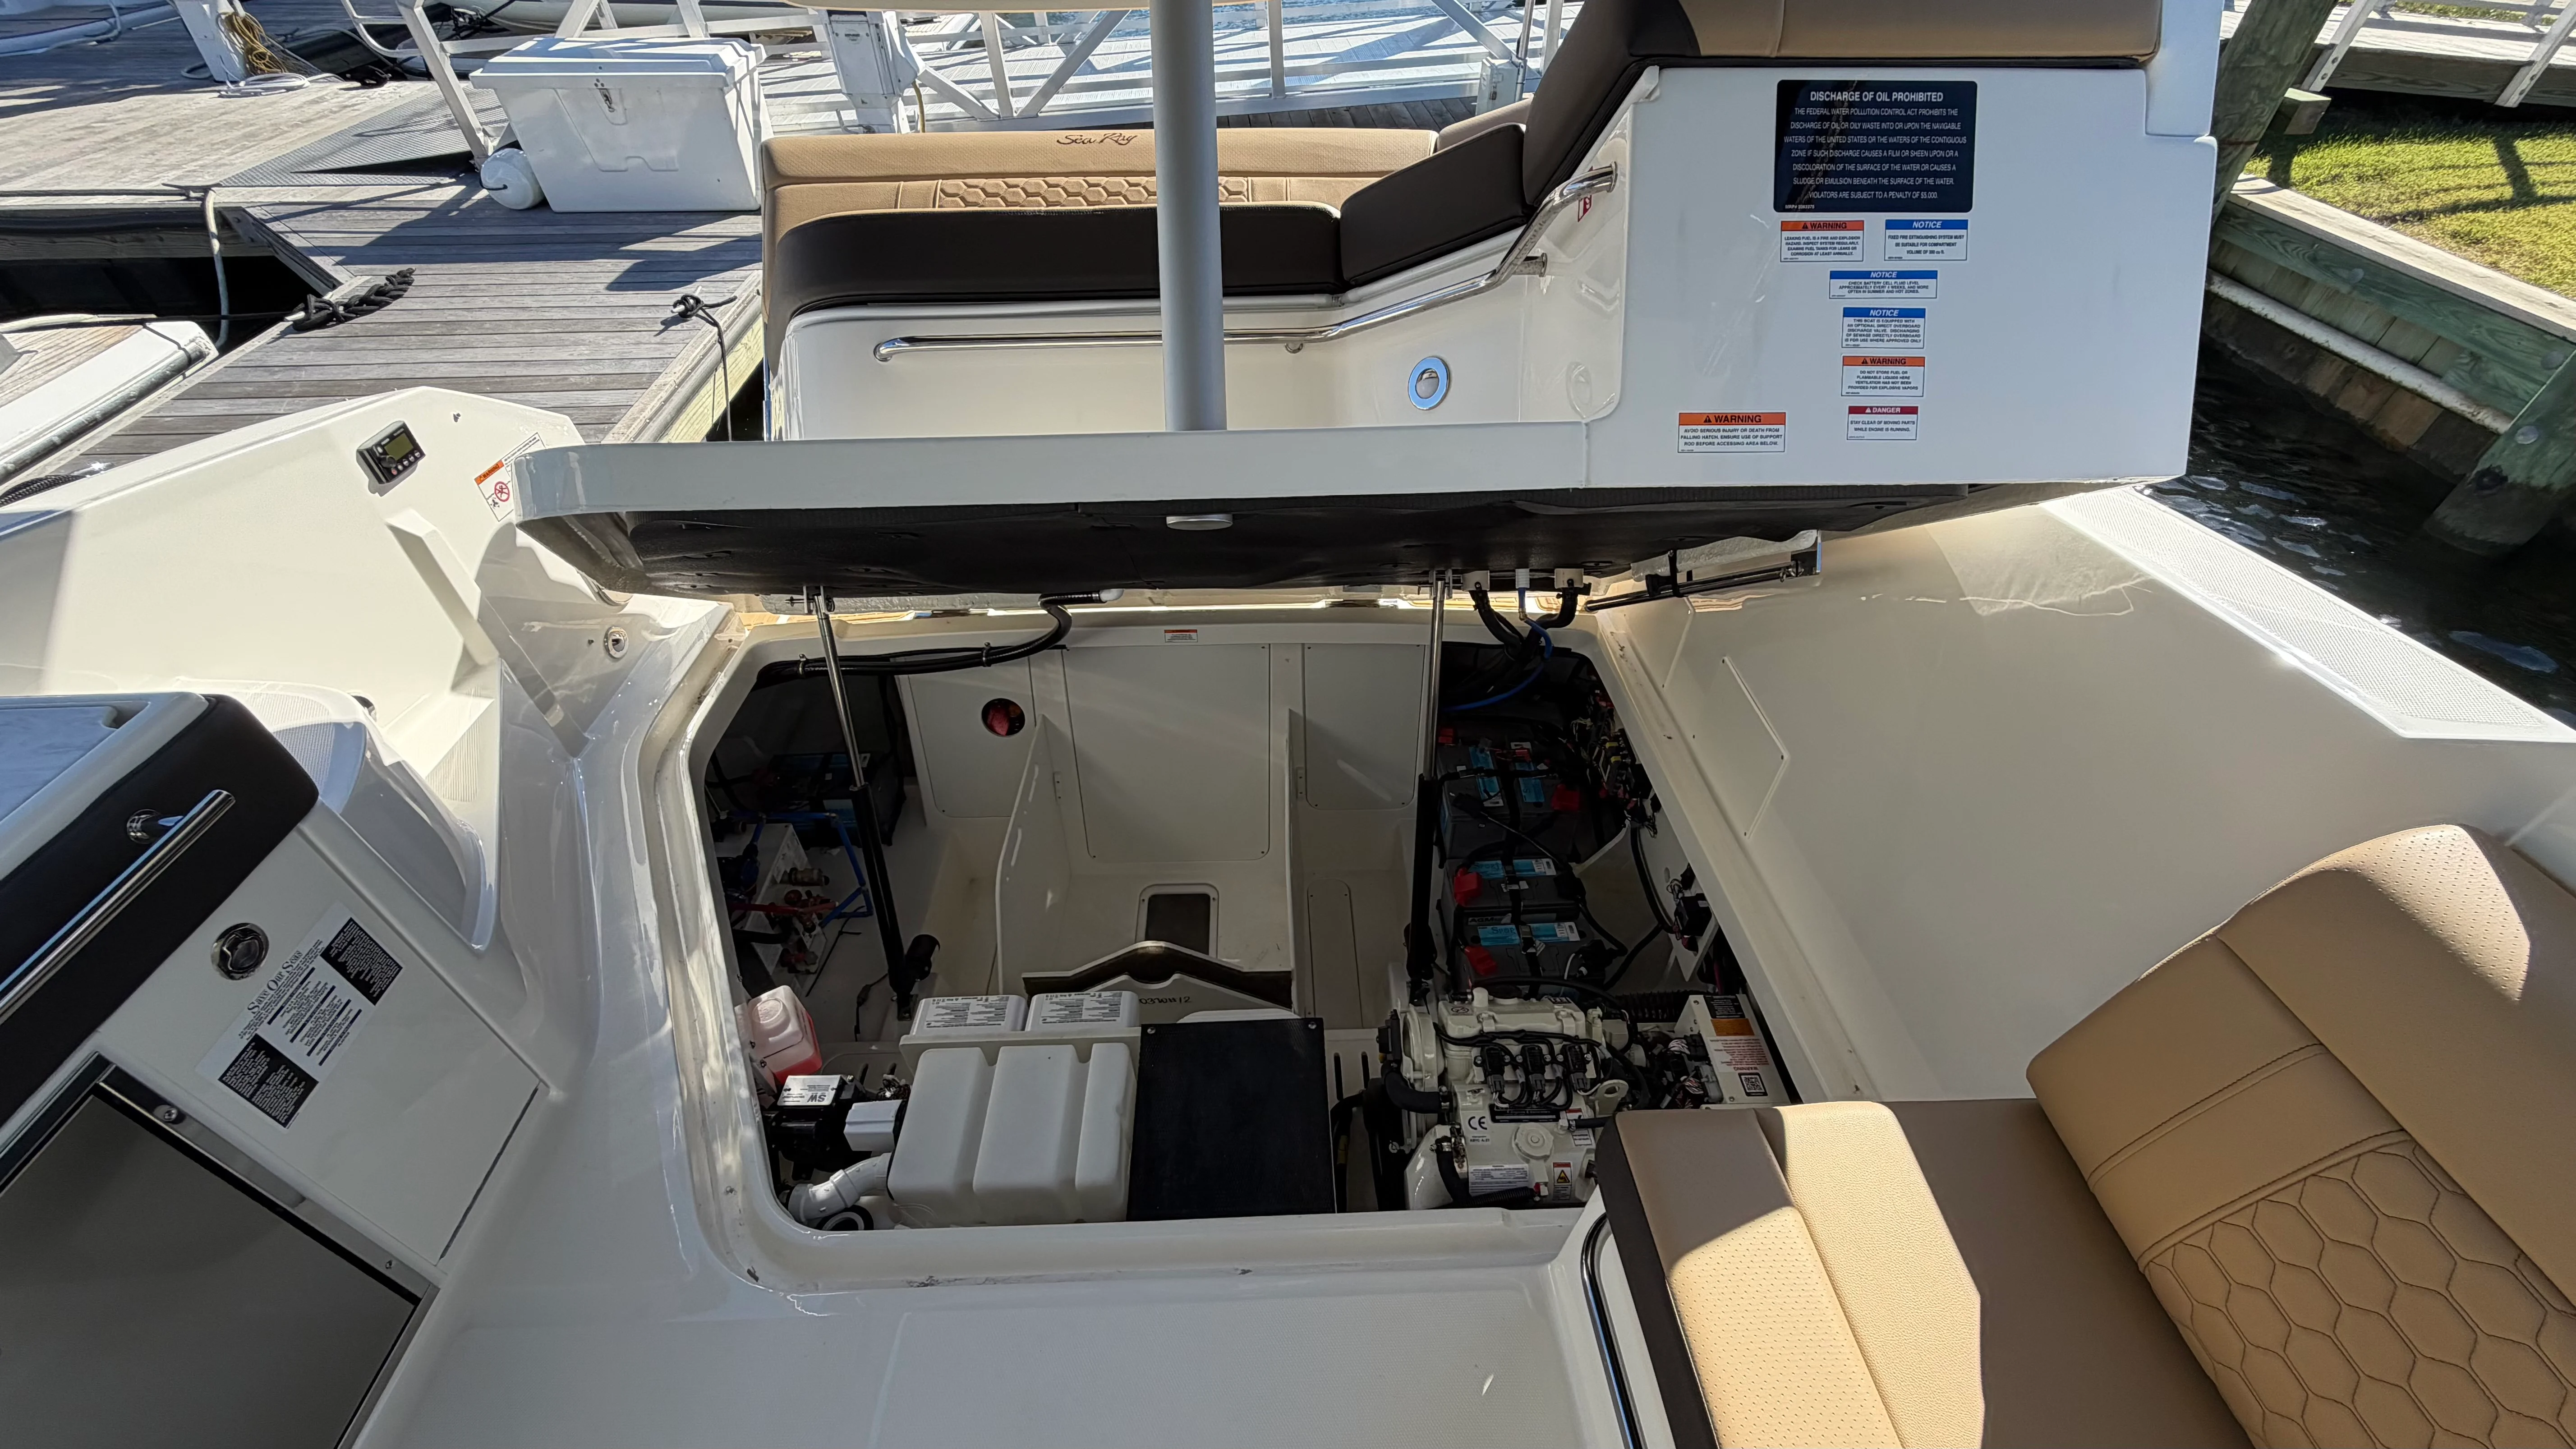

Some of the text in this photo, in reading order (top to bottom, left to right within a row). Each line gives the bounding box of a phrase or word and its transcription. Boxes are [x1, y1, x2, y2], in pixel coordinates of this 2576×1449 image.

[1810, 92, 1943, 101] DISCHARGE OF OIL PROHIBITED
[1057, 133, 1138, 145] Sea Ray
[1715, 415, 1761, 423] WARNING
[248, 988, 268, 1015] Save
[267, 971, 284, 992] Our
[807, 1094, 827, 1103] SW
[1468, 1116, 1487, 1130] CE
